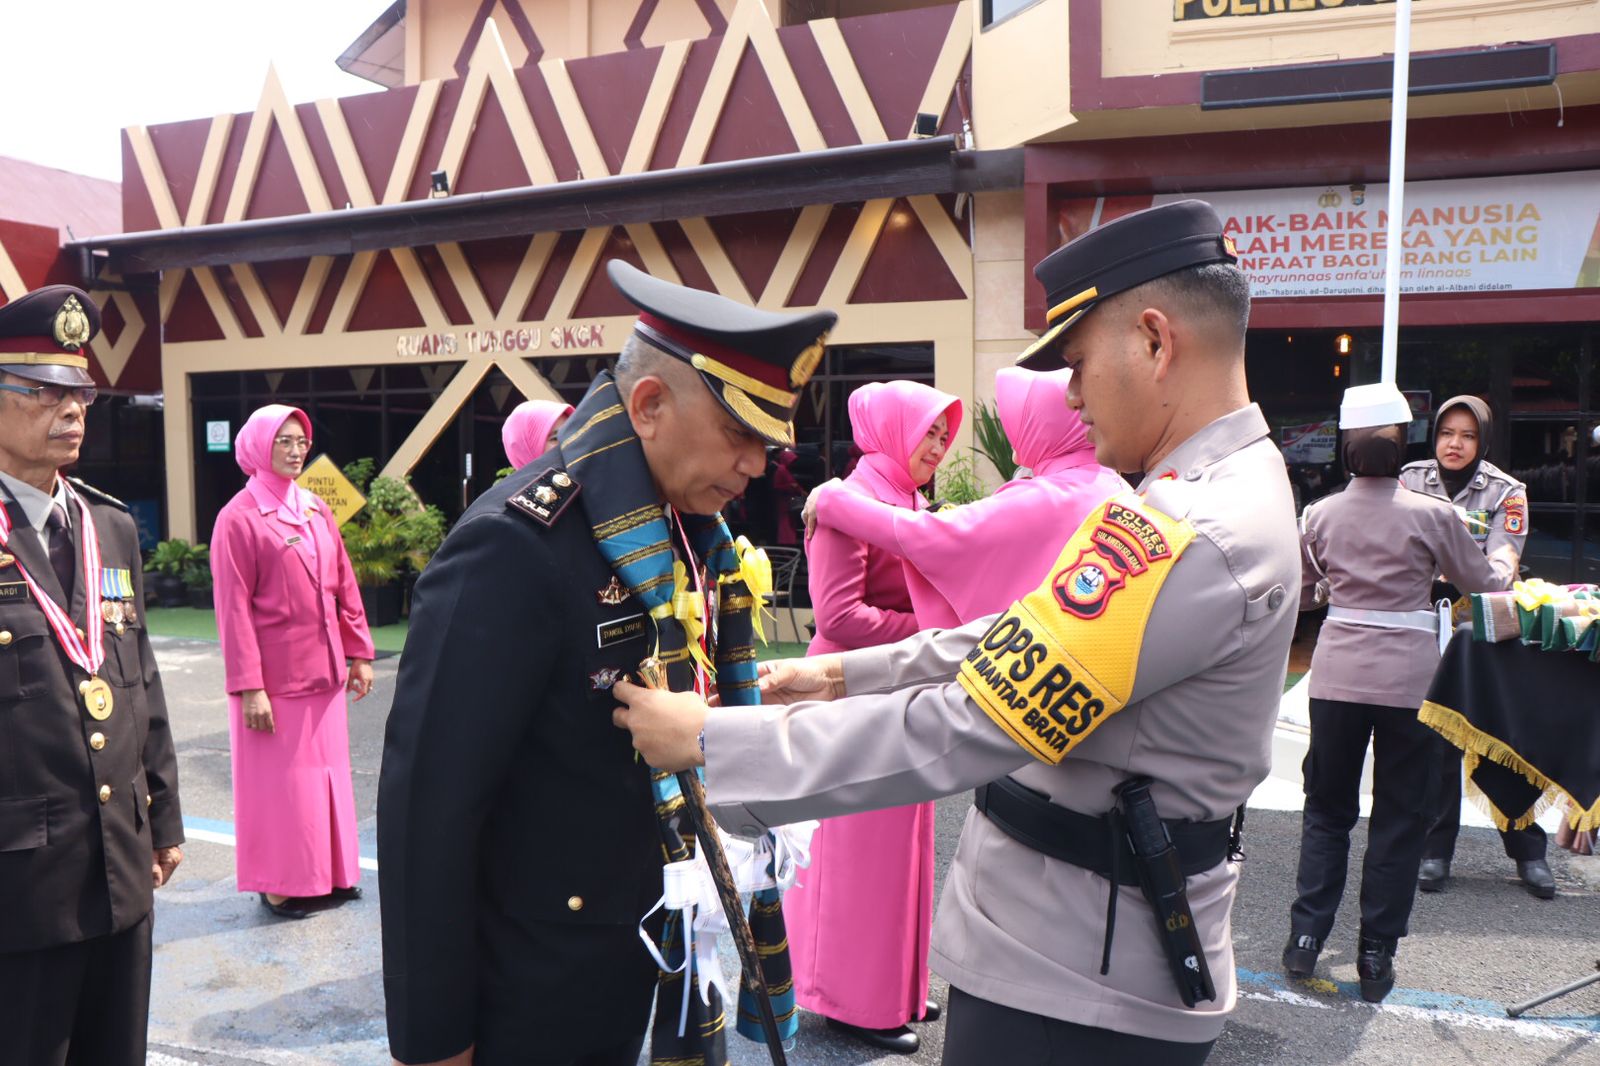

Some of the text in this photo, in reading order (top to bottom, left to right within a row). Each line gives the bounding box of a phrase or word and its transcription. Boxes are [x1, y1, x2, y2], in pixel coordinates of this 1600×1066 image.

[1444, 225, 1538, 247] YANG
[1236, 248, 1537, 270] NFAAT BAGI RANG LAIN
[1247, 272, 1331, 285] hayrunnaas
[1418, 268, 1472, 278] linnaas
[1417, 284, 1435, 293] oleh
[397, 324, 605, 356] RUANG TUNGGU SKCK
[305, 487, 337, 496] ASUK
[307, 476, 335, 486] PINTU
[322, 497, 347, 506] ATAN
[1097, 530, 1125, 550] SULAWESI
[1110, 504, 1166, 554] POLRES
[1115, 516, 1154, 551] SOPPENG
[974, 656, 1070, 753] MANTAP BRATA
[1028, 663, 1104, 735] RES
